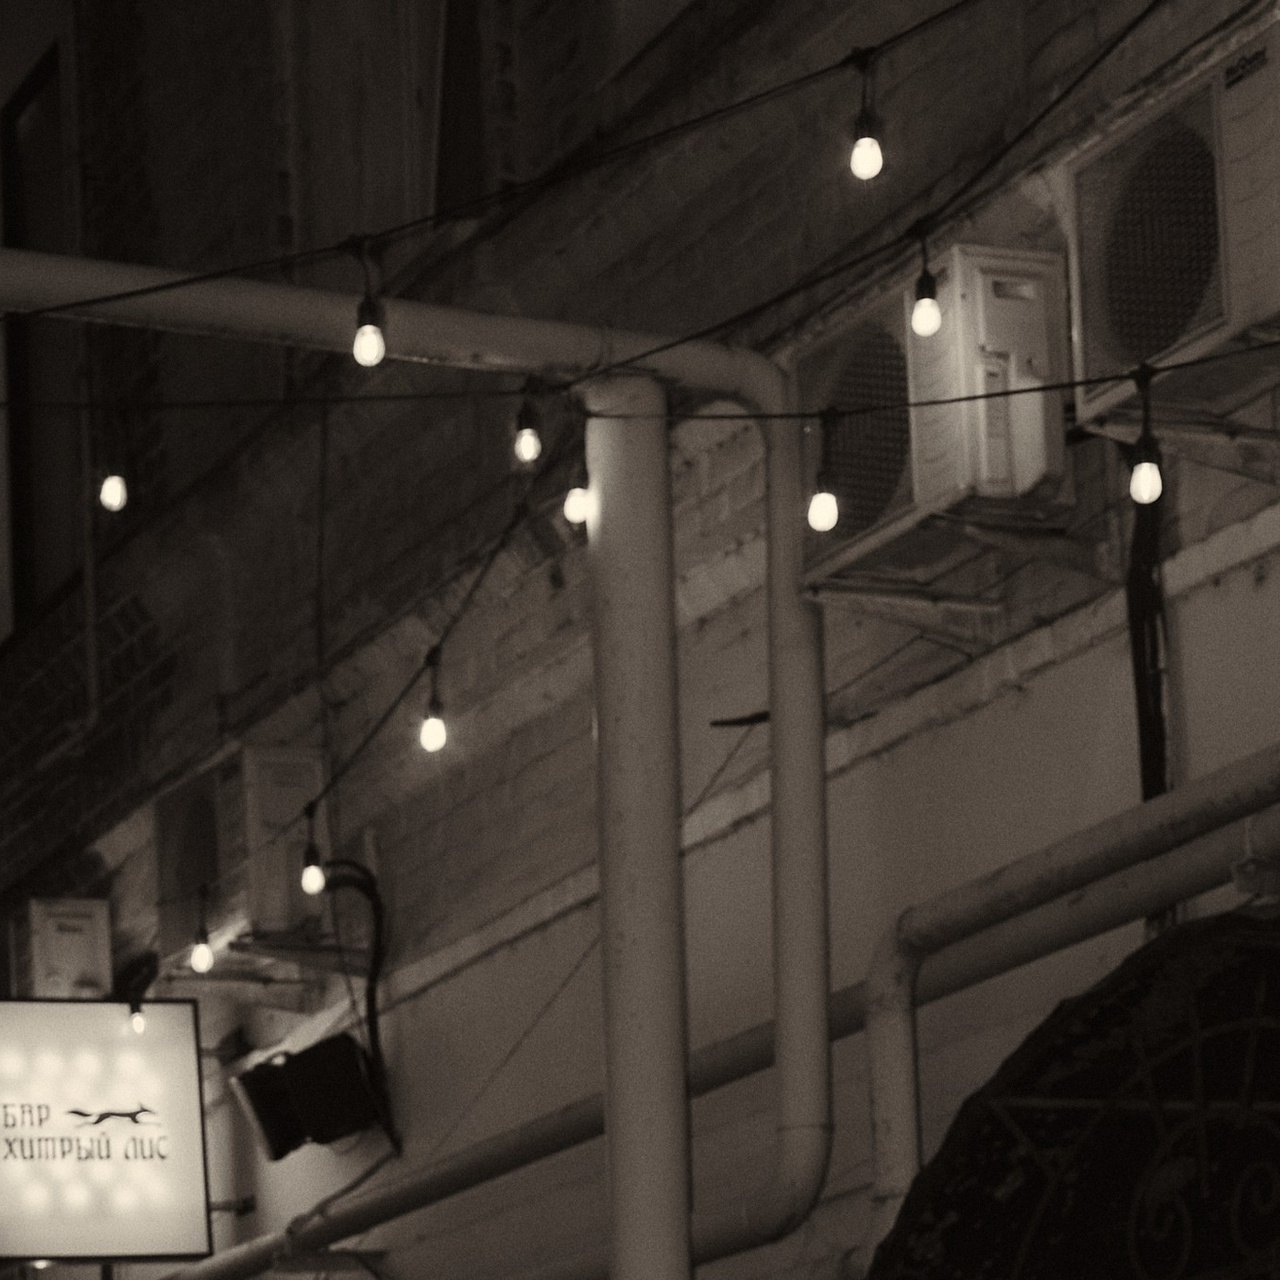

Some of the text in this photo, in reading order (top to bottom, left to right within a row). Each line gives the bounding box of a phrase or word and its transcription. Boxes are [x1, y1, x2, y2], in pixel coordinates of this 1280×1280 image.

[1, 1103, 51, 1130] БАР
[2, 1132, 170, 1162] ХИТРЫЙ ЛИС
